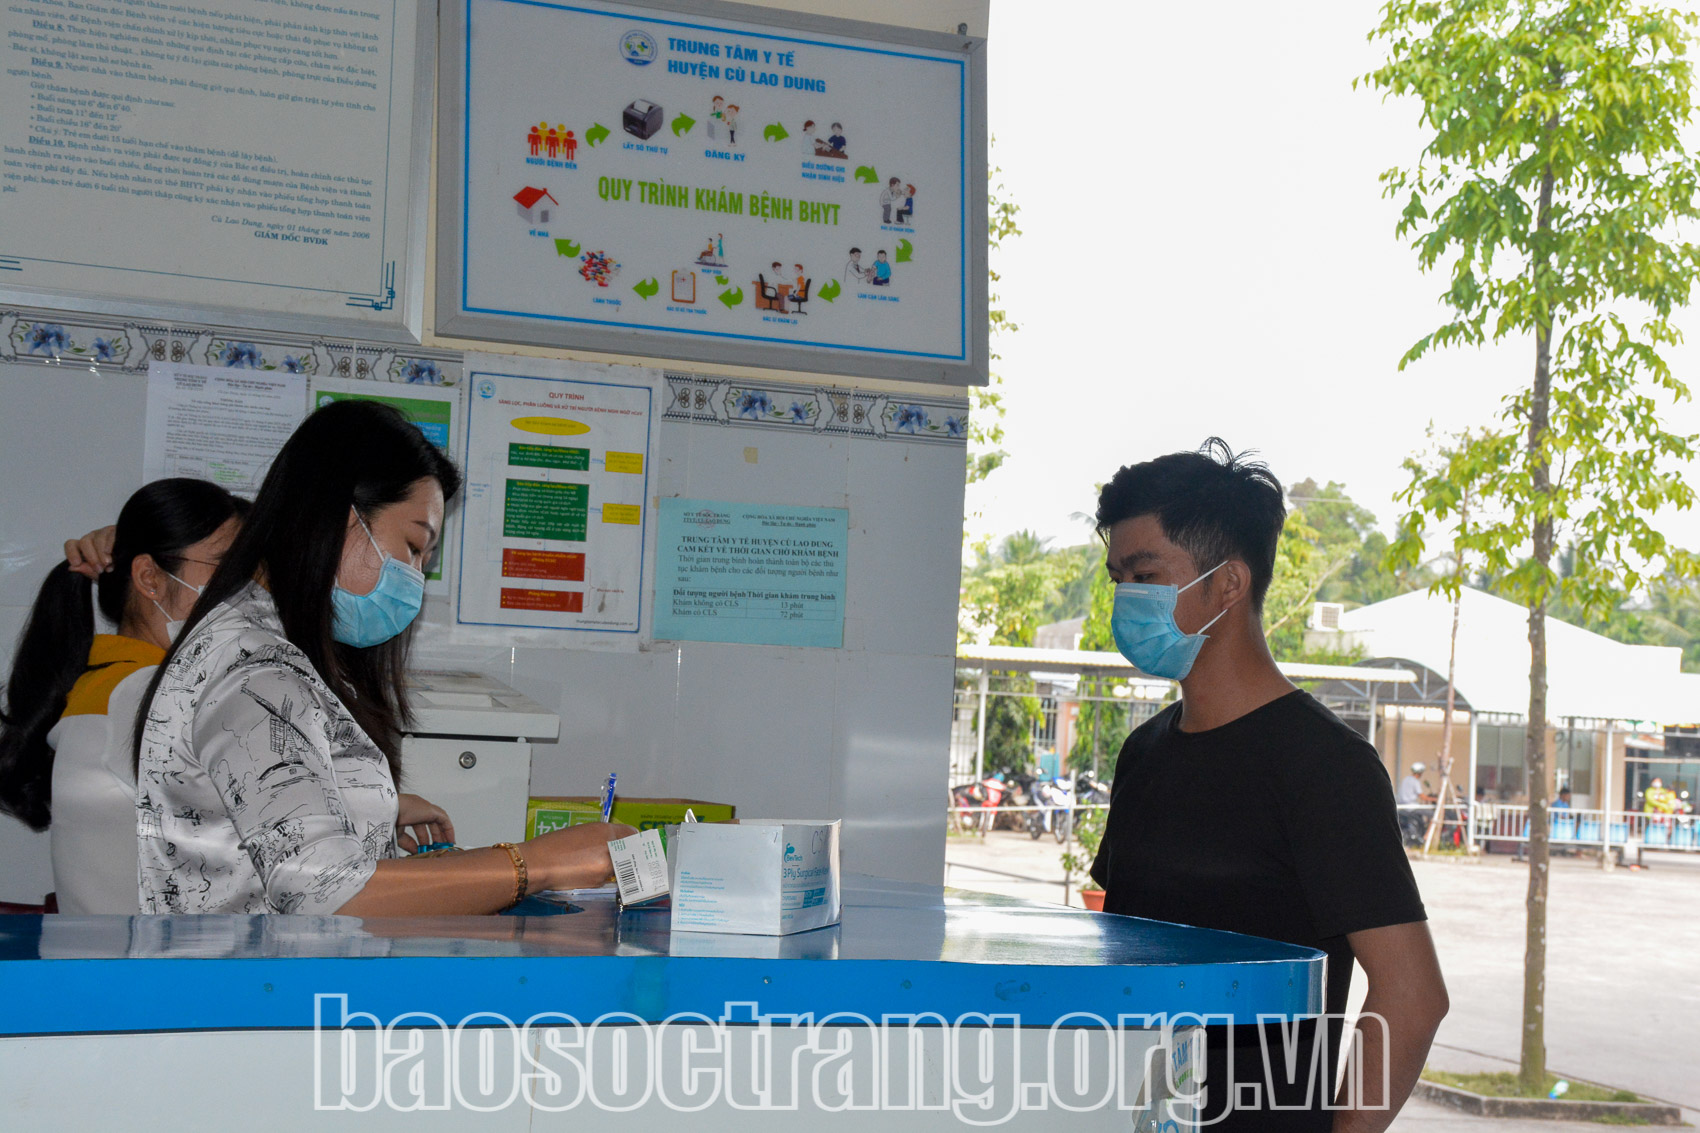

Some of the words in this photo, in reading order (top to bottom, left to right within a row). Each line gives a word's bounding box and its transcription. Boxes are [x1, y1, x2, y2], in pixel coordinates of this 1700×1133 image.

[668, 37, 720, 57] TRUNG
[724, 44, 758, 62] TÂM
[763, 50, 772, 64] Y
[776, 50, 794, 67] TẾ
[668, 59, 720, 80] HUYỆN
[725, 66, 745, 82] CÙ
[750, 70, 778, 86] LAO
[784, 75, 826, 93] DUNG
[704, 150, 730, 160] ĐĂNG
[734, 153, 745, 161] KÝ
[598, 176, 632, 202] QUY
[637, 178, 688, 208] TRÌNH
[695, 186, 742, 214] KHÁM
[750, 190, 792, 223] BỆNH
[800, 200, 840, 226] BHYT
[254, 230, 278, 240] GIÁM
[682, 535, 710, 544] TRUNG
[711, 535, 730, 544] TÂM
[751, 538, 778, 548] HUYỆN
[780, 538, 791, 546] CÙ
[698, 545, 714, 553] KẾT
[716, 545, 727, 553] VỀ
[729, 546, 749, 554] THỜI
[792, 548, 816, 556] KHÁM
[818, 550, 838, 558] BỆNH
